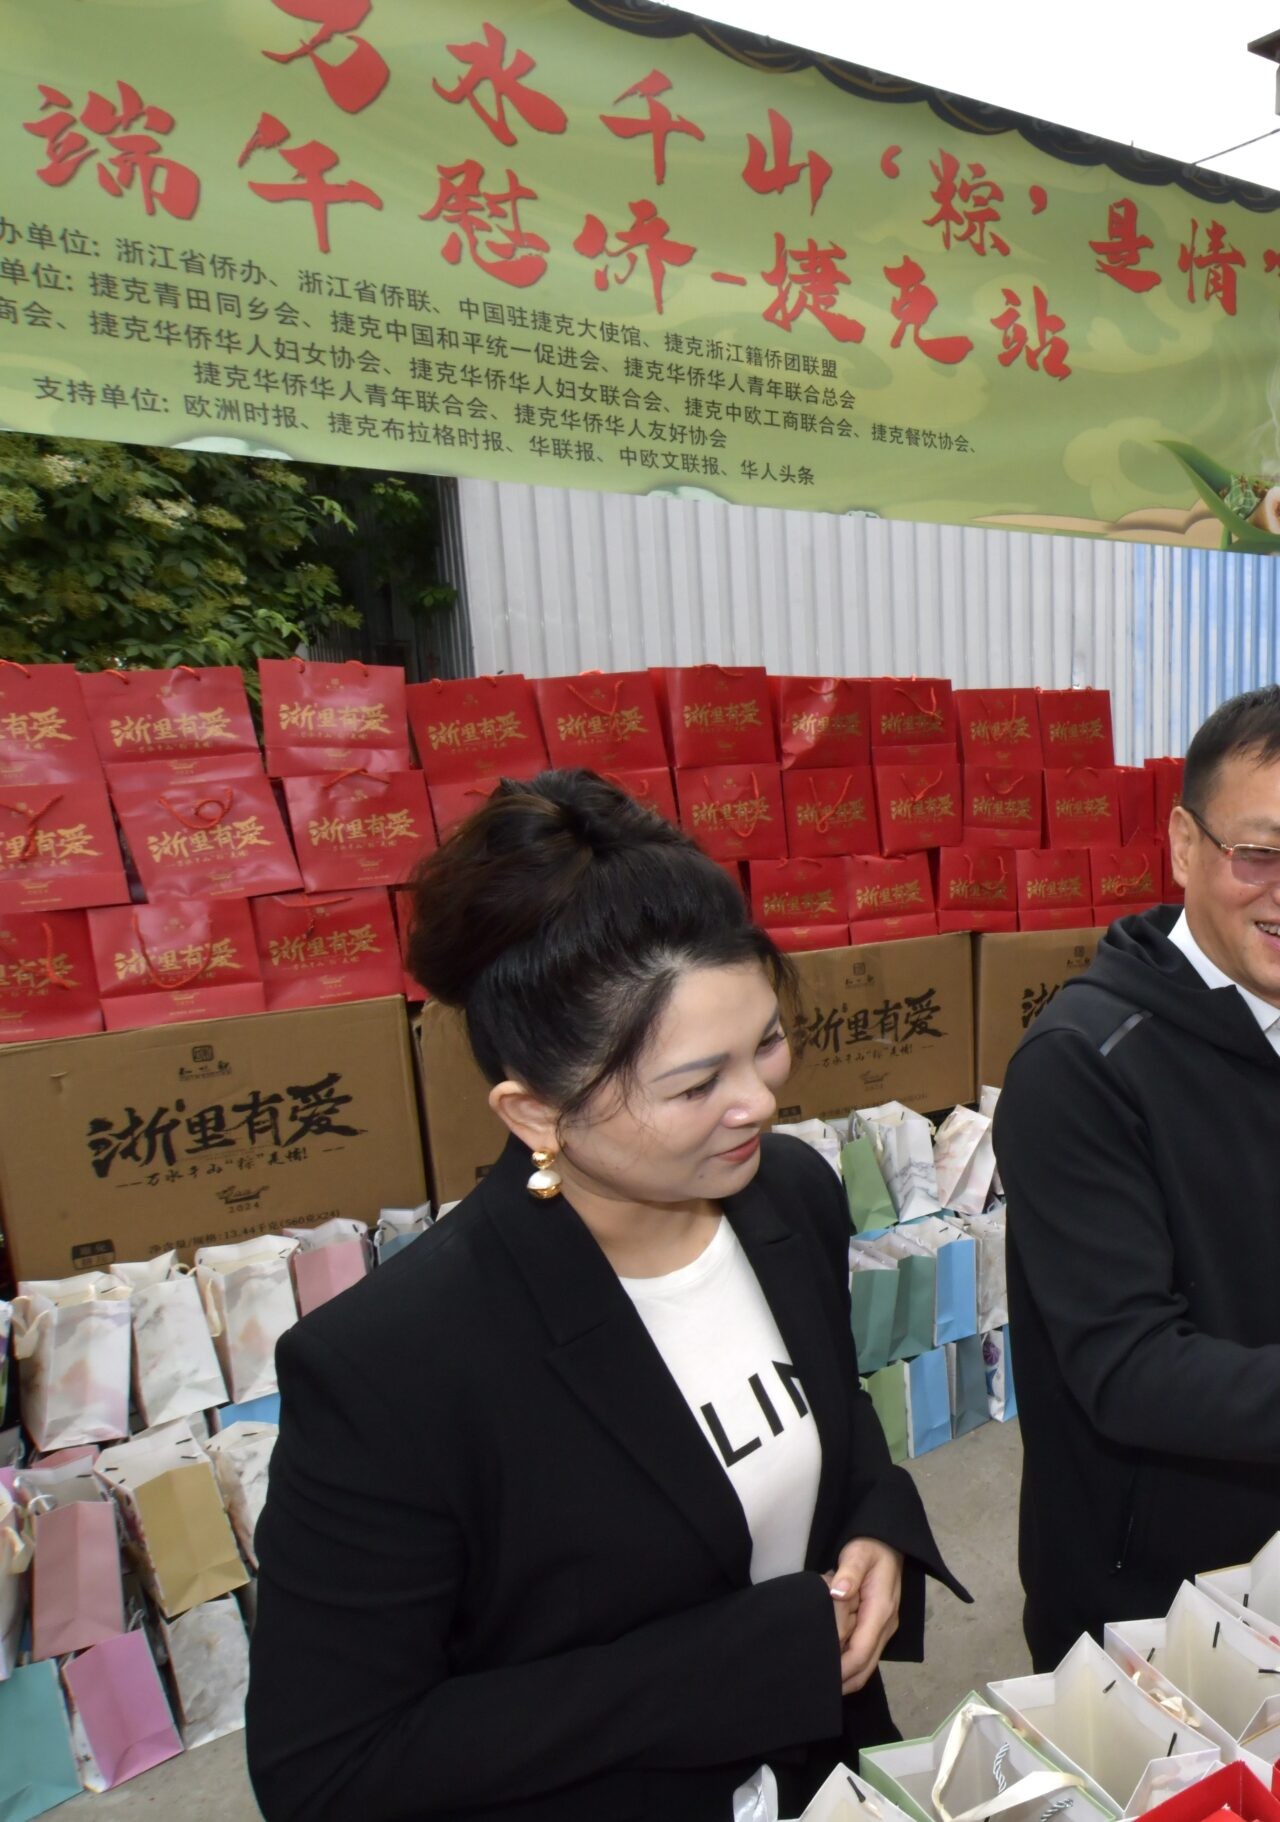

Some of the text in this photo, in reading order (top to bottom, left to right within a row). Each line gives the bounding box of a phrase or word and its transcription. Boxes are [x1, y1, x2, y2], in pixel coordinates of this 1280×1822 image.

[0, 707, 76, 742] 有爱
[109, 707, 240, 748] 浙里有爱
[279, 702, 394, 735] 浙里有爱
[428, 712, 527, 750] 浙里有爱
[683, 700, 762, 728] 浙里有爱
[692, 797, 773, 826] 浙里有爱
[891, 794, 955, 820] 浙里有爱
[0, 824, 102, 860] 里有爱
[148, 816, 274, 862] 浙里有爱
[308, 809, 422, 846] 浙里有爱
[856, 880, 924, 909] 浙里有爱
[115, 938, 243, 979] 浙里有爱
[269, 924, 382, 966] 浙里有爱
[793, 987, 948, 1058] 浙里有爱
[86, 1073, 368, 1178] 浙里有爱
[228, 1202, 260, 1214] 2024
